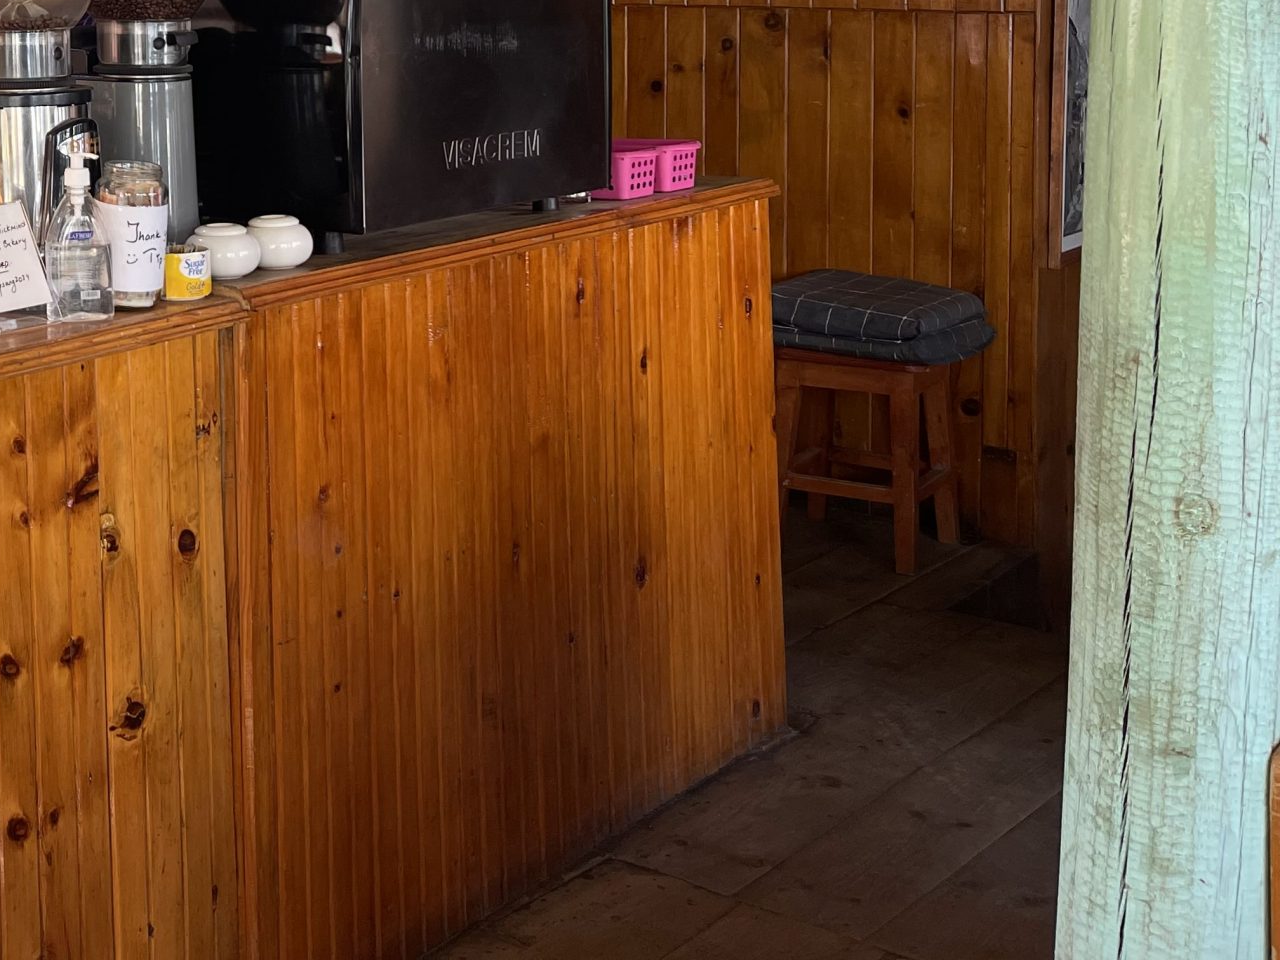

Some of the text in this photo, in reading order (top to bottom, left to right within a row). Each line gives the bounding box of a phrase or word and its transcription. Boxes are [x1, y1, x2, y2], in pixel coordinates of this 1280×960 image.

[443, 129, 543, 170] VISACREM
[184, 259, 204, 270] Sugar
[189, 267, 202, 276] Free
